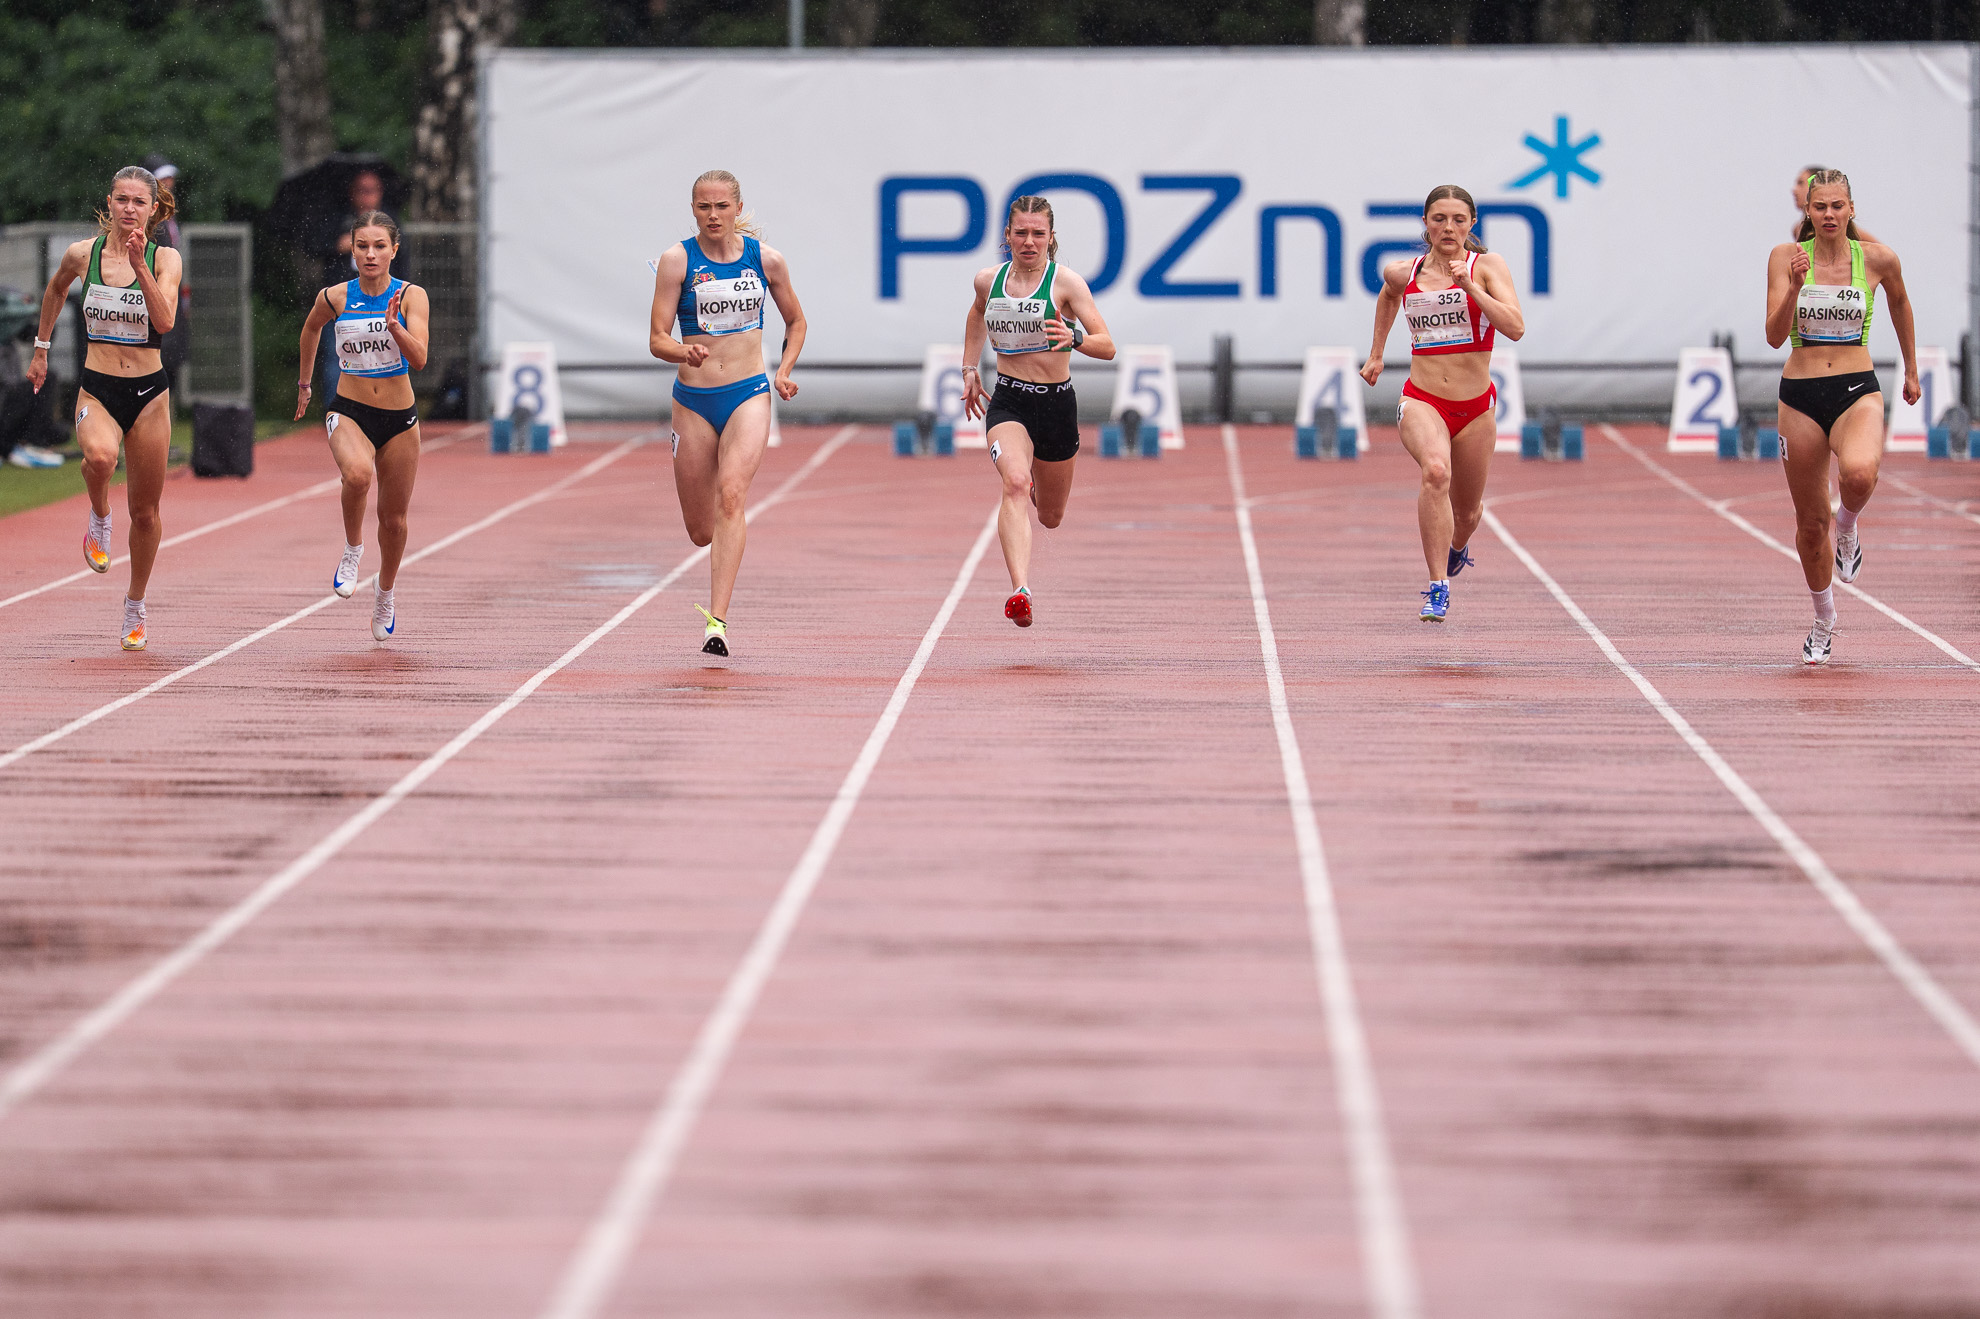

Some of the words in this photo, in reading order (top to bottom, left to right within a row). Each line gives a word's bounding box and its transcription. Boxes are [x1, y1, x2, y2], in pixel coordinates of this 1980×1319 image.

[733, 281, 758, 292] 621
[1836, 289, 1860, 301] 494
[120, 293, 144, 305] 428
[700, 297, 762, 315] KOPYŁEK
[1017, 301, 1041, 313] 145
[1438, 292, 1462, 305] 352
[85, 306, 146, 325] GRUCHLIK
[1408, 310, 1467, 329] WROTEK
[1799, 305, 1863, 321] BASIŃSKA
[367, 321, 389, 333] 107
[986, 320, 1043, 334] MARCYNIUK
[341, 339, 392, 354] CIUPAK
[512, 366, 545, 417] 8
[935, 367, 966, 420] 6
[1011, 380, 1049, 394] PRO
[1131, 368, 1164, 425] 5
[1311, 367, 1350, 425] 4
[1688, 370, 1722, 424] 2
[1919, 371, 1934, 427] 1
[326, 414, 335, 433] 7
